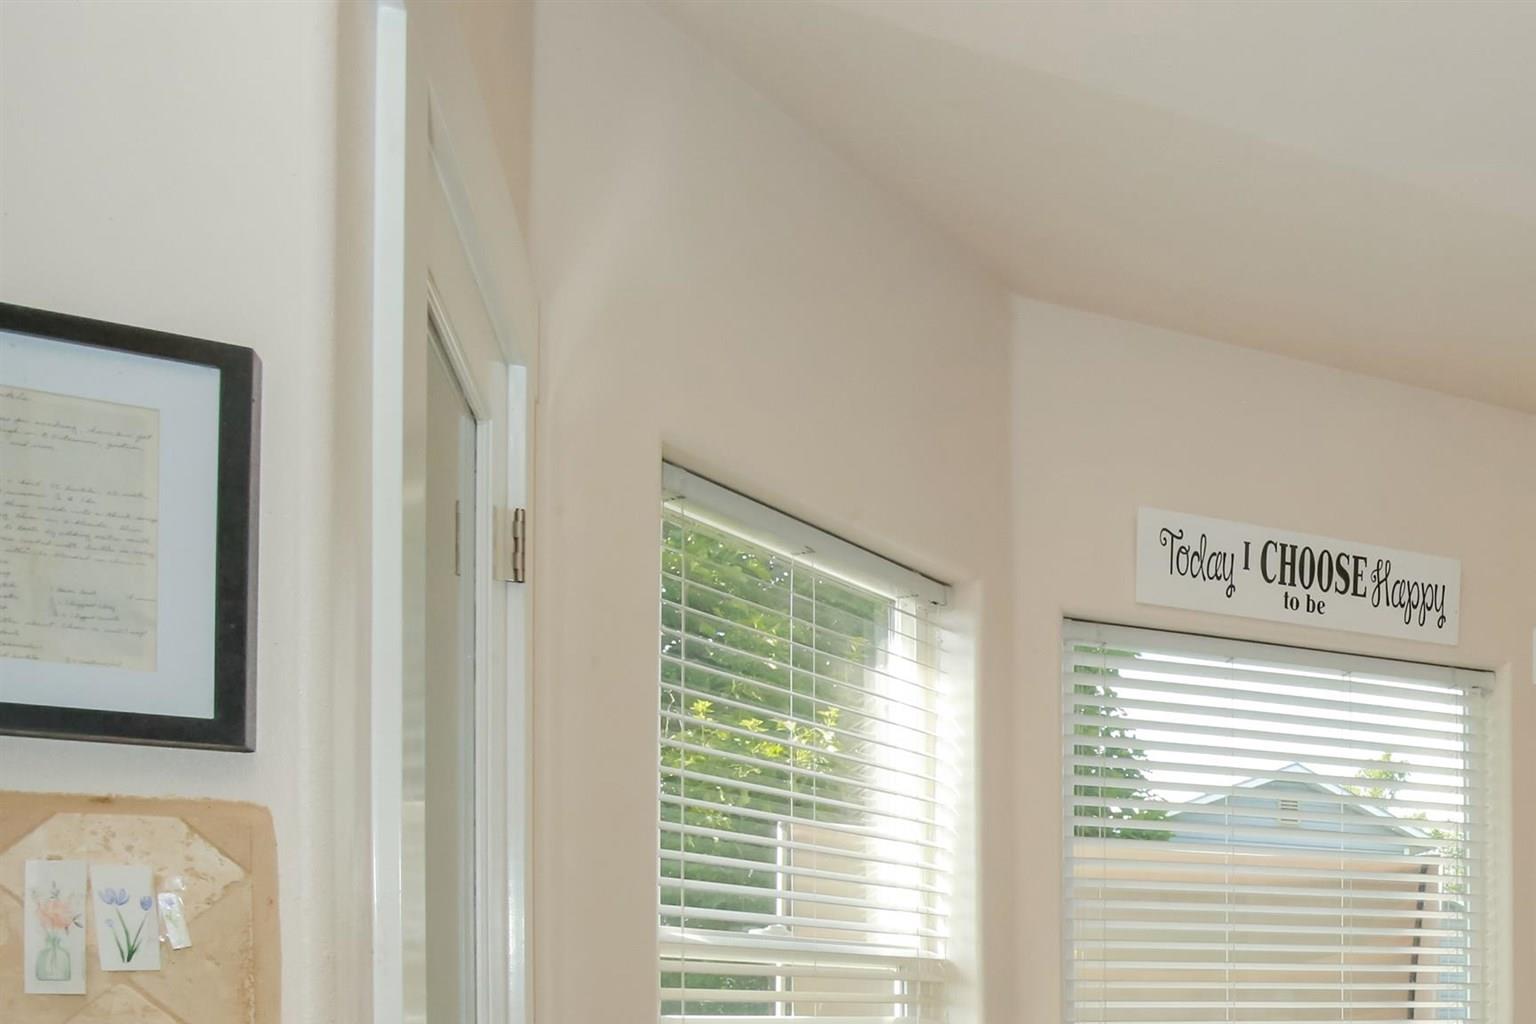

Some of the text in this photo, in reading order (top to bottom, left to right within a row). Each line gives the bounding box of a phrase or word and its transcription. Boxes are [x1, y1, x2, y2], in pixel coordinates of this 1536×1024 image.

[1159, 527, 1446, 629] Today I CHOOSE Happy
[1283, 590, 1326, 615] to be
